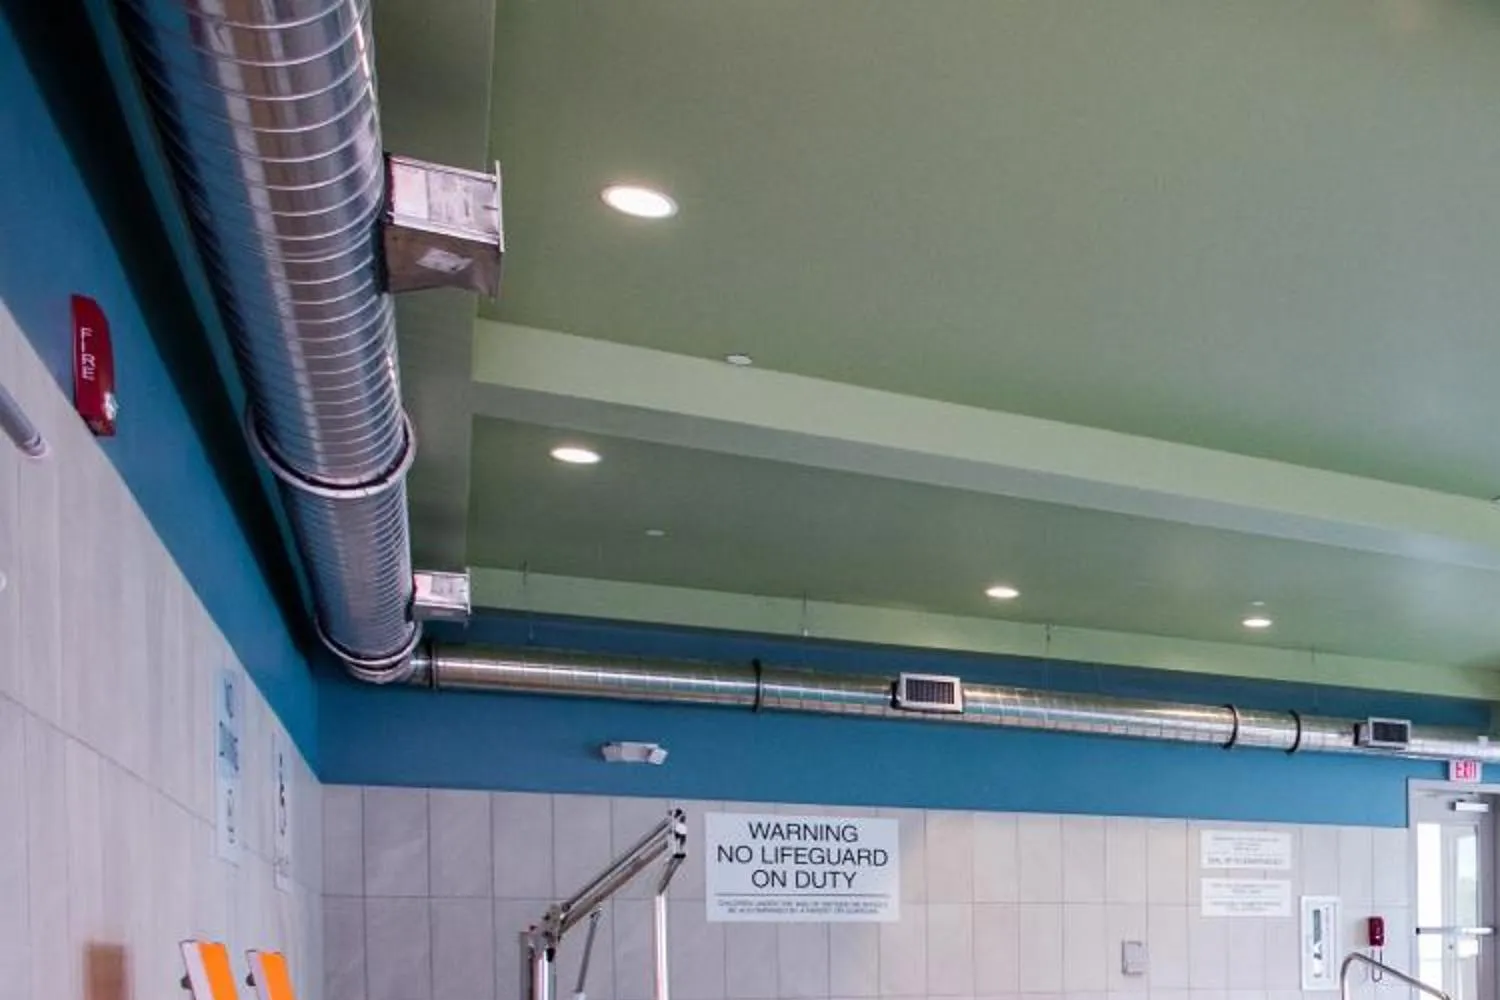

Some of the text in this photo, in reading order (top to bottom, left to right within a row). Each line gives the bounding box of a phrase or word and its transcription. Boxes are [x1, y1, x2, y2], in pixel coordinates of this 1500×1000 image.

[80, 327, 95, 381] FIRE
[748, 821, 859, 842] WARNING
[717, 845, 889, 866] NO LIFEGUARD
[751, 869, 857, 889] ON DUTY
